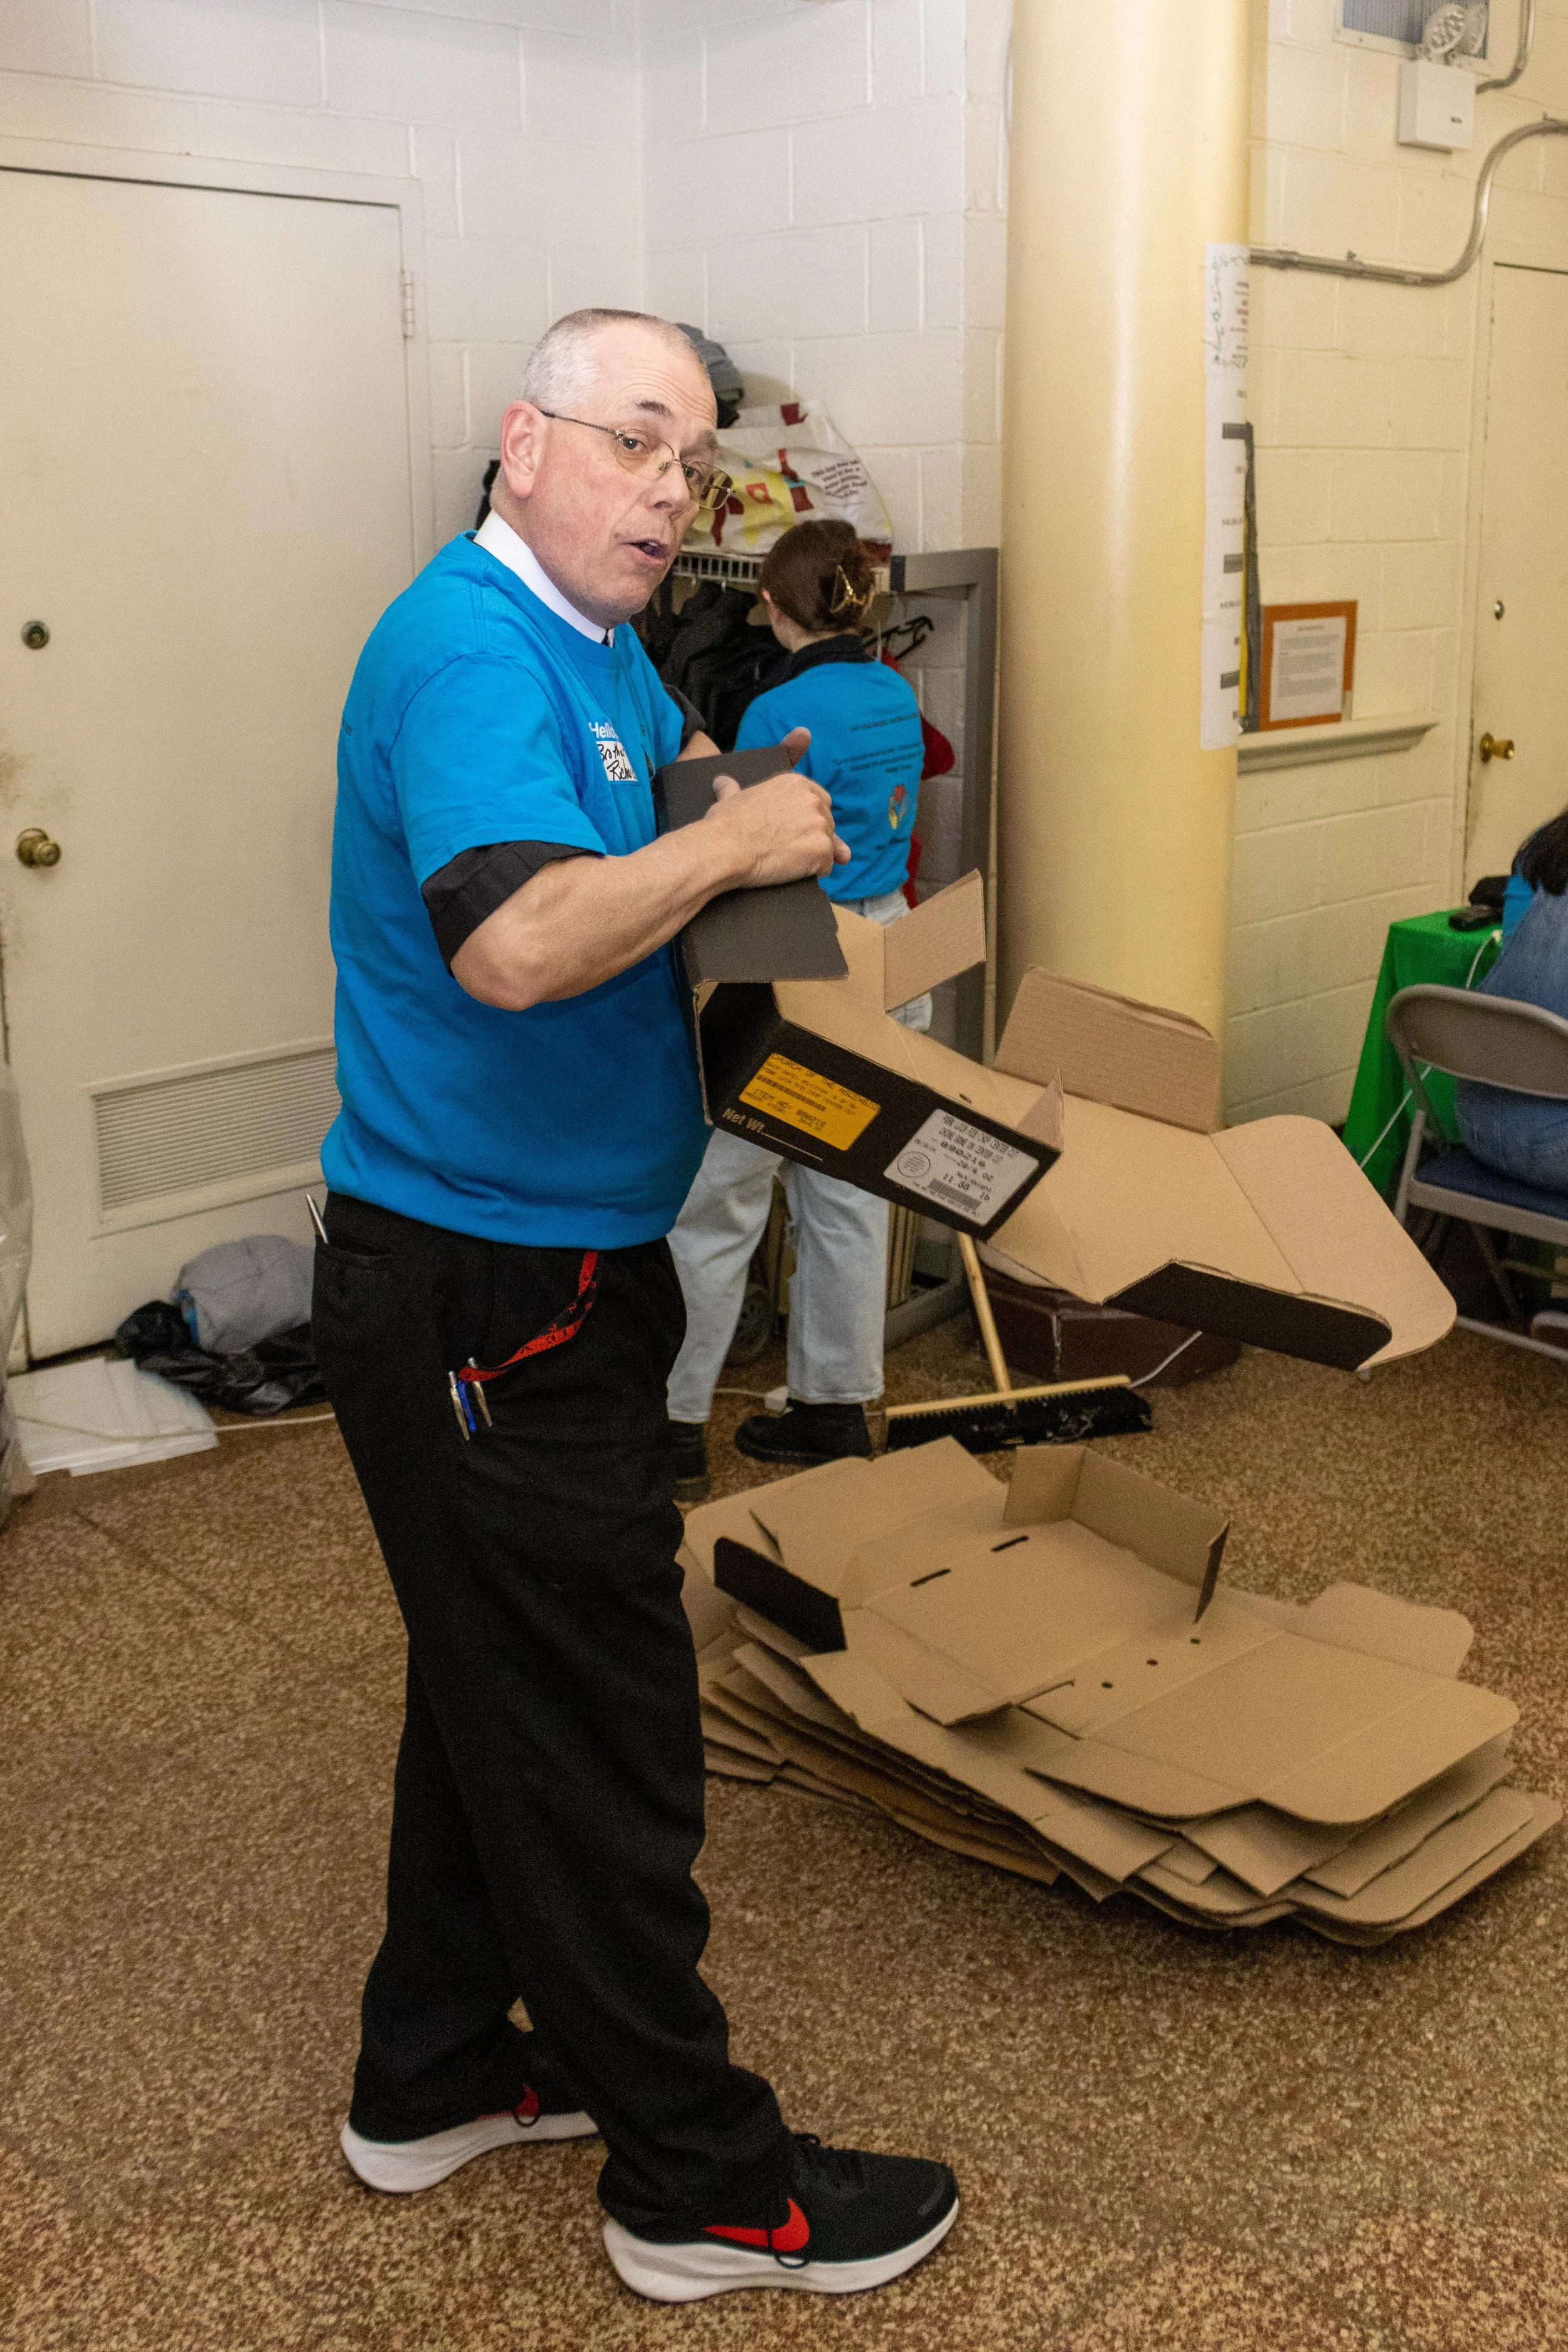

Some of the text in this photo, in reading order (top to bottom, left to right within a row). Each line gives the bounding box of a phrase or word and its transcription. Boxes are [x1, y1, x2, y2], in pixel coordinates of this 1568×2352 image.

[770, 1052, 803, 1072] CHURCH
[753, 1088, 775, 1102] ITEM
[723, 1108, 746, 1125] Net
